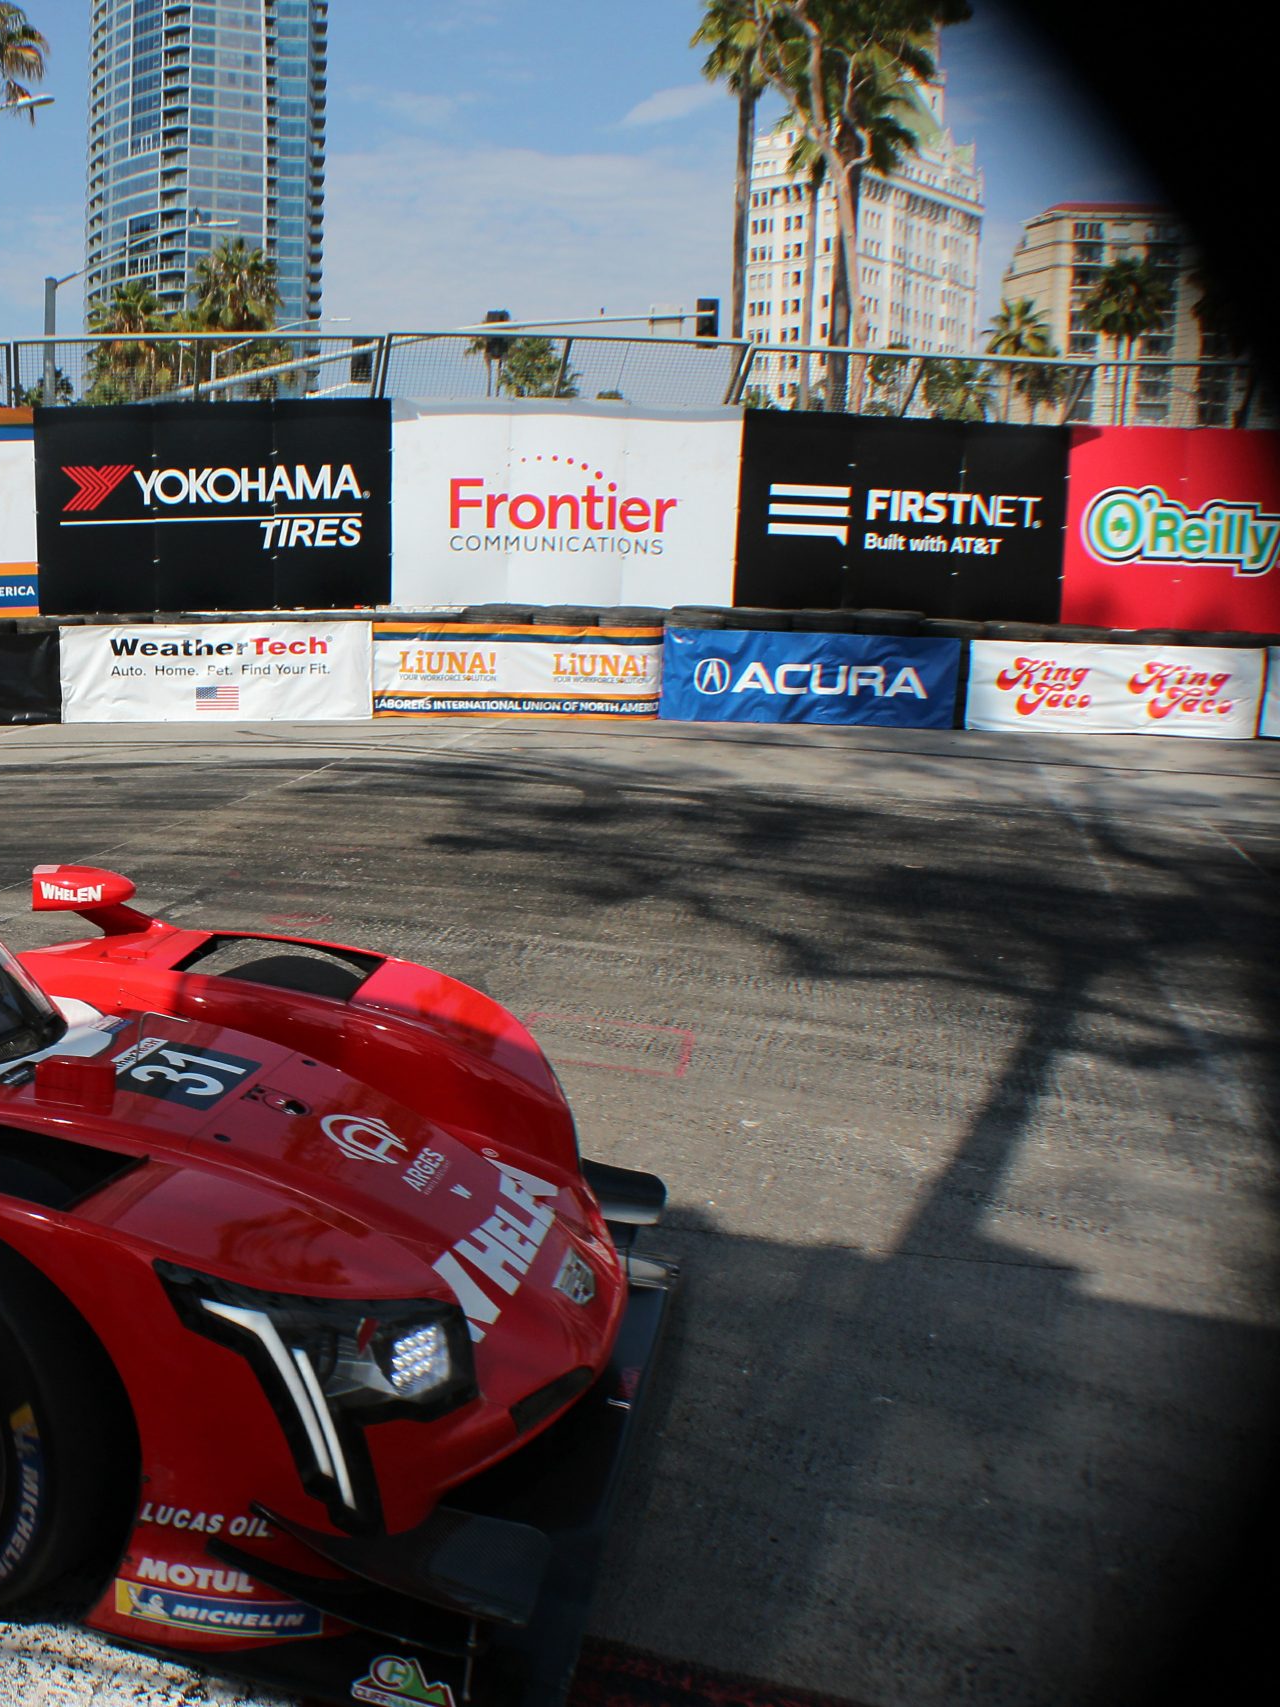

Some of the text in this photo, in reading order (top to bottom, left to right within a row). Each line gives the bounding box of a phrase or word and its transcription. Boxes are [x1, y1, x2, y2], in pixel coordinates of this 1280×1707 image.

[133, 464, 362, 506] YOKOHAMA
[449, 478, 677, 534] Frontier
[259, 518, 363, 550] TIRES
[450, 534, 664, 556] COMMUNICATIONS
[864, 532, 1004, 556] Built with AT&T
[1089, 491, 1280, 571] O'Reilly
[110, 636, 329, 657] WeatherTech
[399, 650, 496, 675] LiUNA!
[110, 663, 331, 678] Auto. Home. Pet. Find Your Fit.
[552, 652, 649, 677] LiUNA!
[730, 661, 928, 700] ACURA
[996, 656, 1091, 691] King
[1127, 660, 1233, 695] King
[433, 699, 521, 711] INTERNATIONAL
[522, 700, 561, 712] UNION
[562, 701, 579, 712] OF
[579, 702, 620, 713] NORTH
[1016, 681, 1092, 716] Taco
[1146, 686, 1234, 719] Taco
[40, 880, 104, 903] WHELEN
[130, 1050, 247, 1096] 31
[401, 1147, 445, 1192] ARGES
[140, 1502, 272, 1538] LUCAS OIL
[136, 1557, 254, 1594] MOTUL
[171, 1603, 306, 1628] MICHELIN
